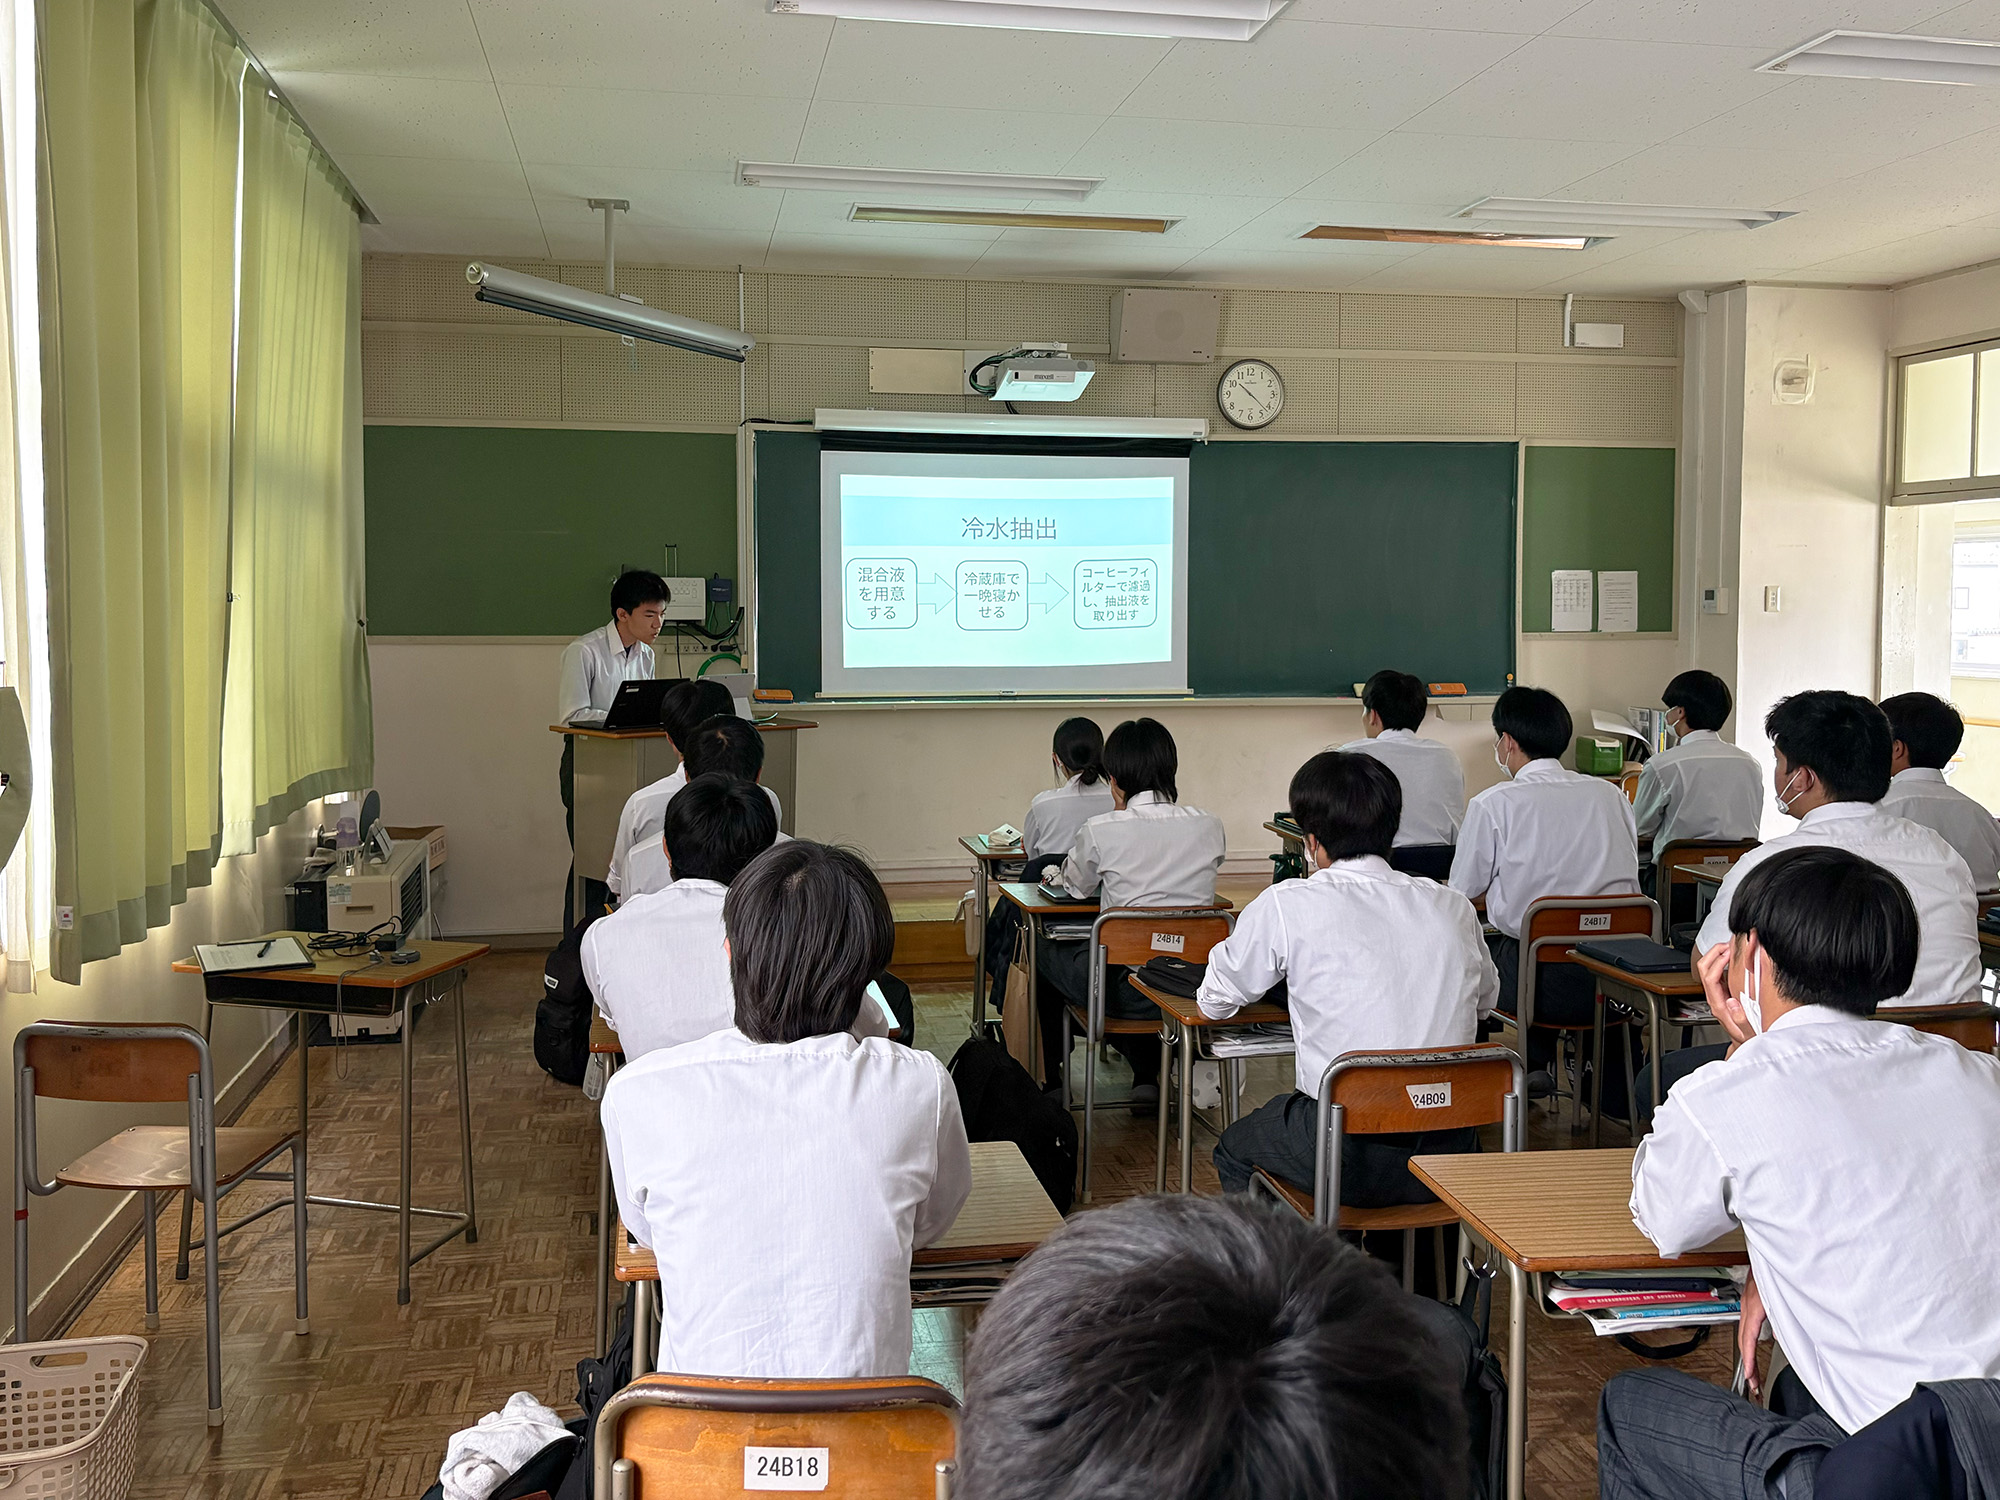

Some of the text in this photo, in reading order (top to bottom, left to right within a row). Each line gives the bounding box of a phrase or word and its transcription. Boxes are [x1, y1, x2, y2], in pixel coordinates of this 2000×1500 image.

[1237, 371, 1244, 380] 11
[1246, 368, 1256, 376] 12
[1260, 371, 1264, 380] 1
[1229, 380, 1238, 388] 10
[1267, 379, 1273, 388] 2
[1225, 390, 1231, 399] 9
[1270, 390, 1276, 399] 3
[1229, 402, 1235, 410] 8
[1265, 401, 1272, 410] 4
[1238, 409, 1244, 418] 7
[1247, 412, 1254, 420] 6
[1258, 409, 1264, 418] 5
[961, 516, 1057, 540] 冷水抽出
[858, 566, 906, 583] 混合液
[1082, 567, 1149, 578] コーヒーフィ
[964, 571, 1020, 586] 冷蔵庫で
[859, 586, 906, 602] を用意
[964, 588, 1021, 603] 一晩寝か
[1083, 594, 1150, 608] し、抽出液を
[866, 605, 897, 621] する
[978, 606, 1006, 619] せる
[1093, 609, 1139, 622] 取り出す
[1583, 916, 1608, 926] 24B17
[1156, 933, 1181, 945] 24B14
[1412, 1092, 1446, 1106] 24B09
[757, 1456, 819, 1477] 24B18
